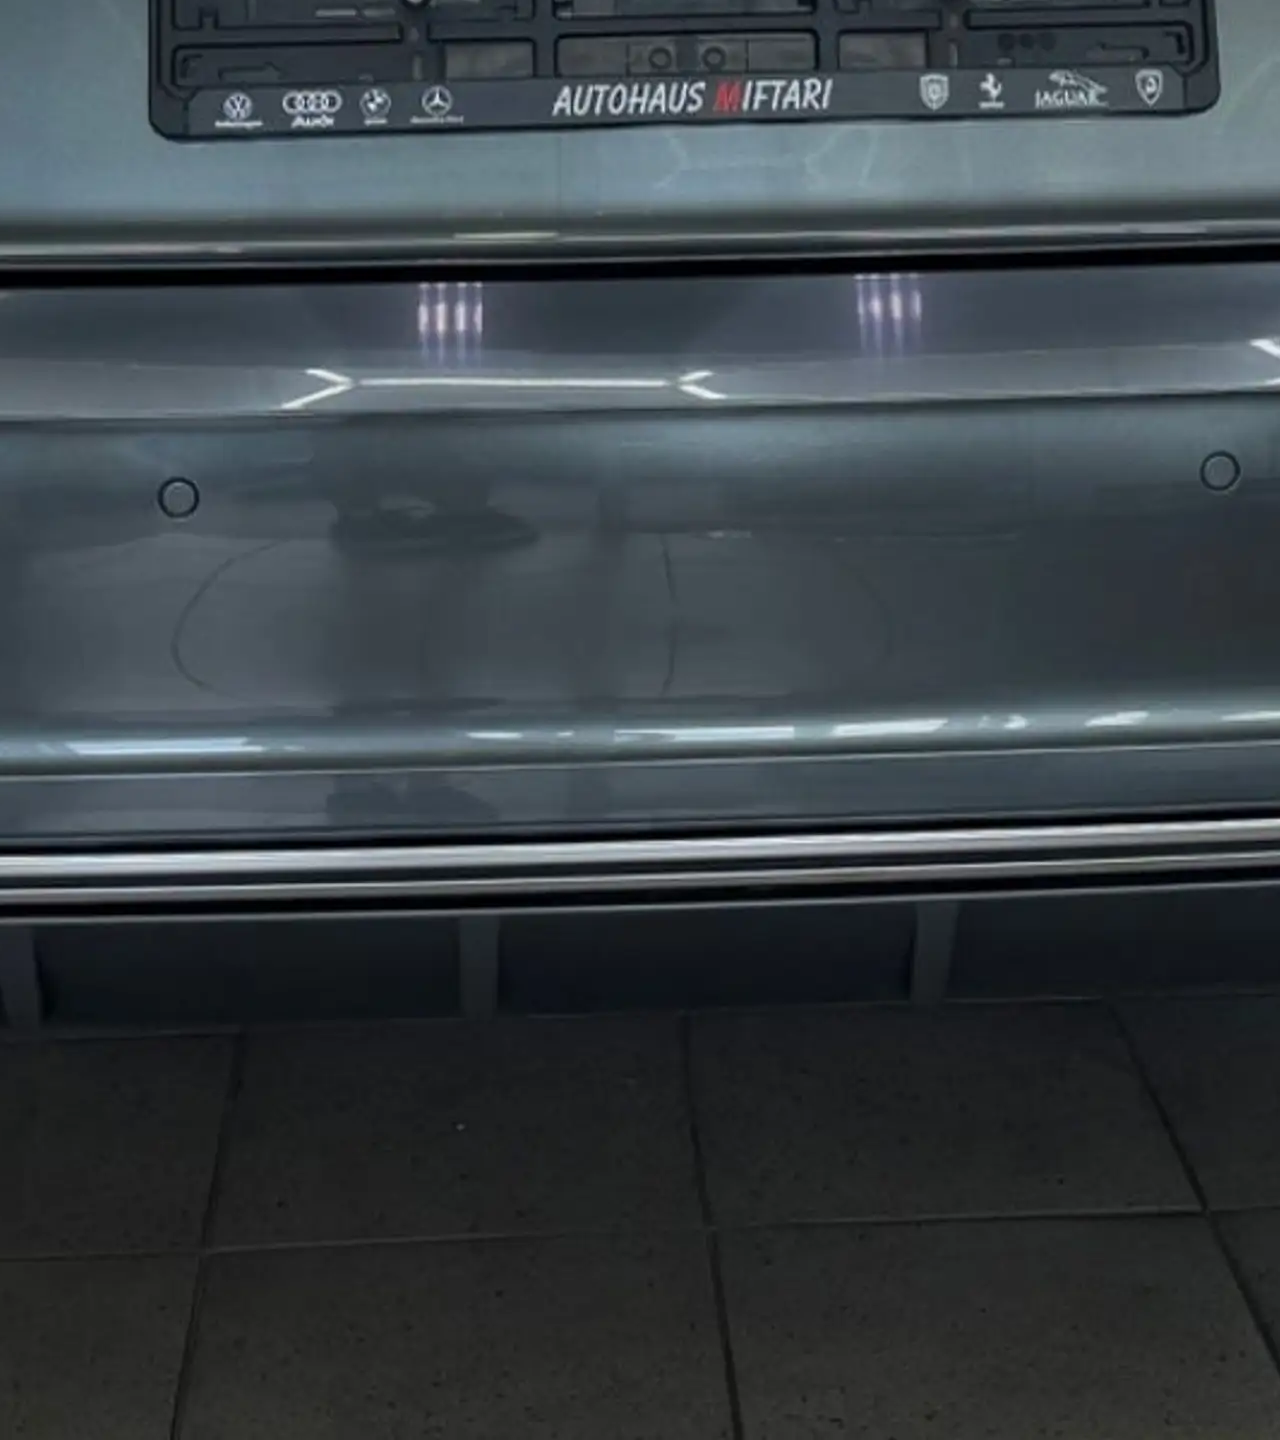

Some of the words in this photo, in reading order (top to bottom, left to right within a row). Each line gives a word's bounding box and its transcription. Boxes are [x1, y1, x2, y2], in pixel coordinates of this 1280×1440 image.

[552, 81, 706, 116] AUTOHAUS
[713, 78, 833, 112] MIFTARI
[1034, 88, 1108, 110] JAGUAR
